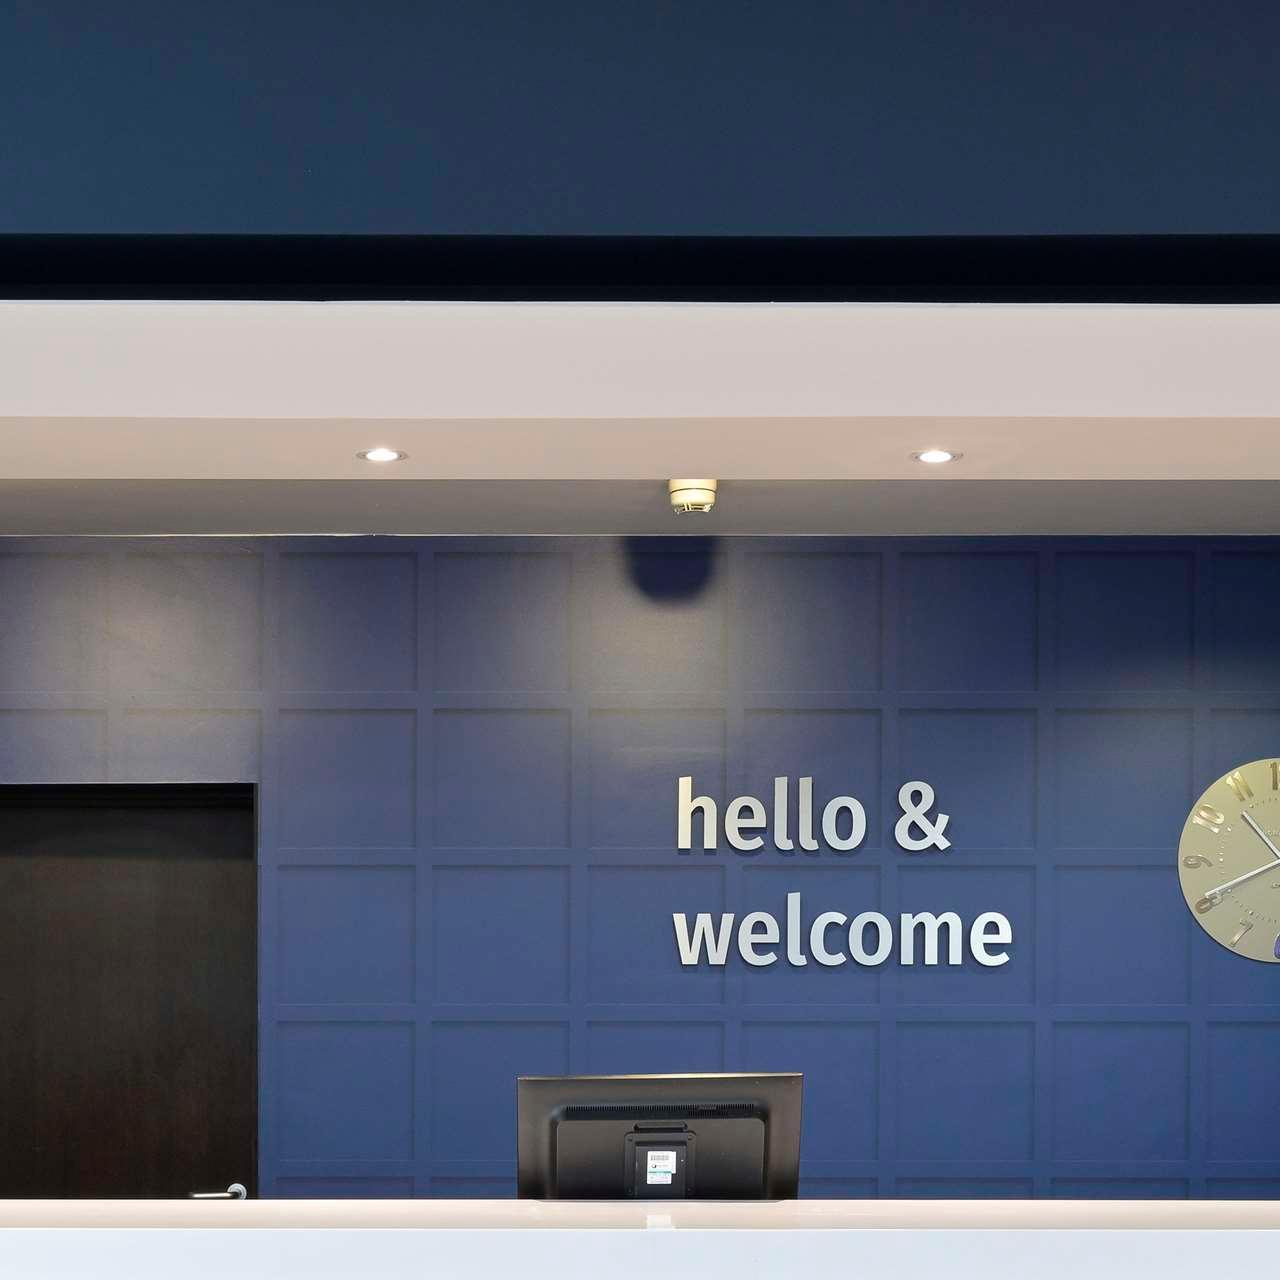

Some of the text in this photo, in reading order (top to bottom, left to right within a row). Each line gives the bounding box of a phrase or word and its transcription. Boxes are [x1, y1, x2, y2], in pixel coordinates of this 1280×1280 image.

[1225, 771, 1254, 802] 11
[677, 775, 952, 852] hello &
[1192, 803, 1225, 834] 10
[1182, 854, 1213, 870] 9
[1194, 892, 1224, 915] 8
[672, 891, 1013, 967] welcome
[1230, 919, 1254, 948] 7
